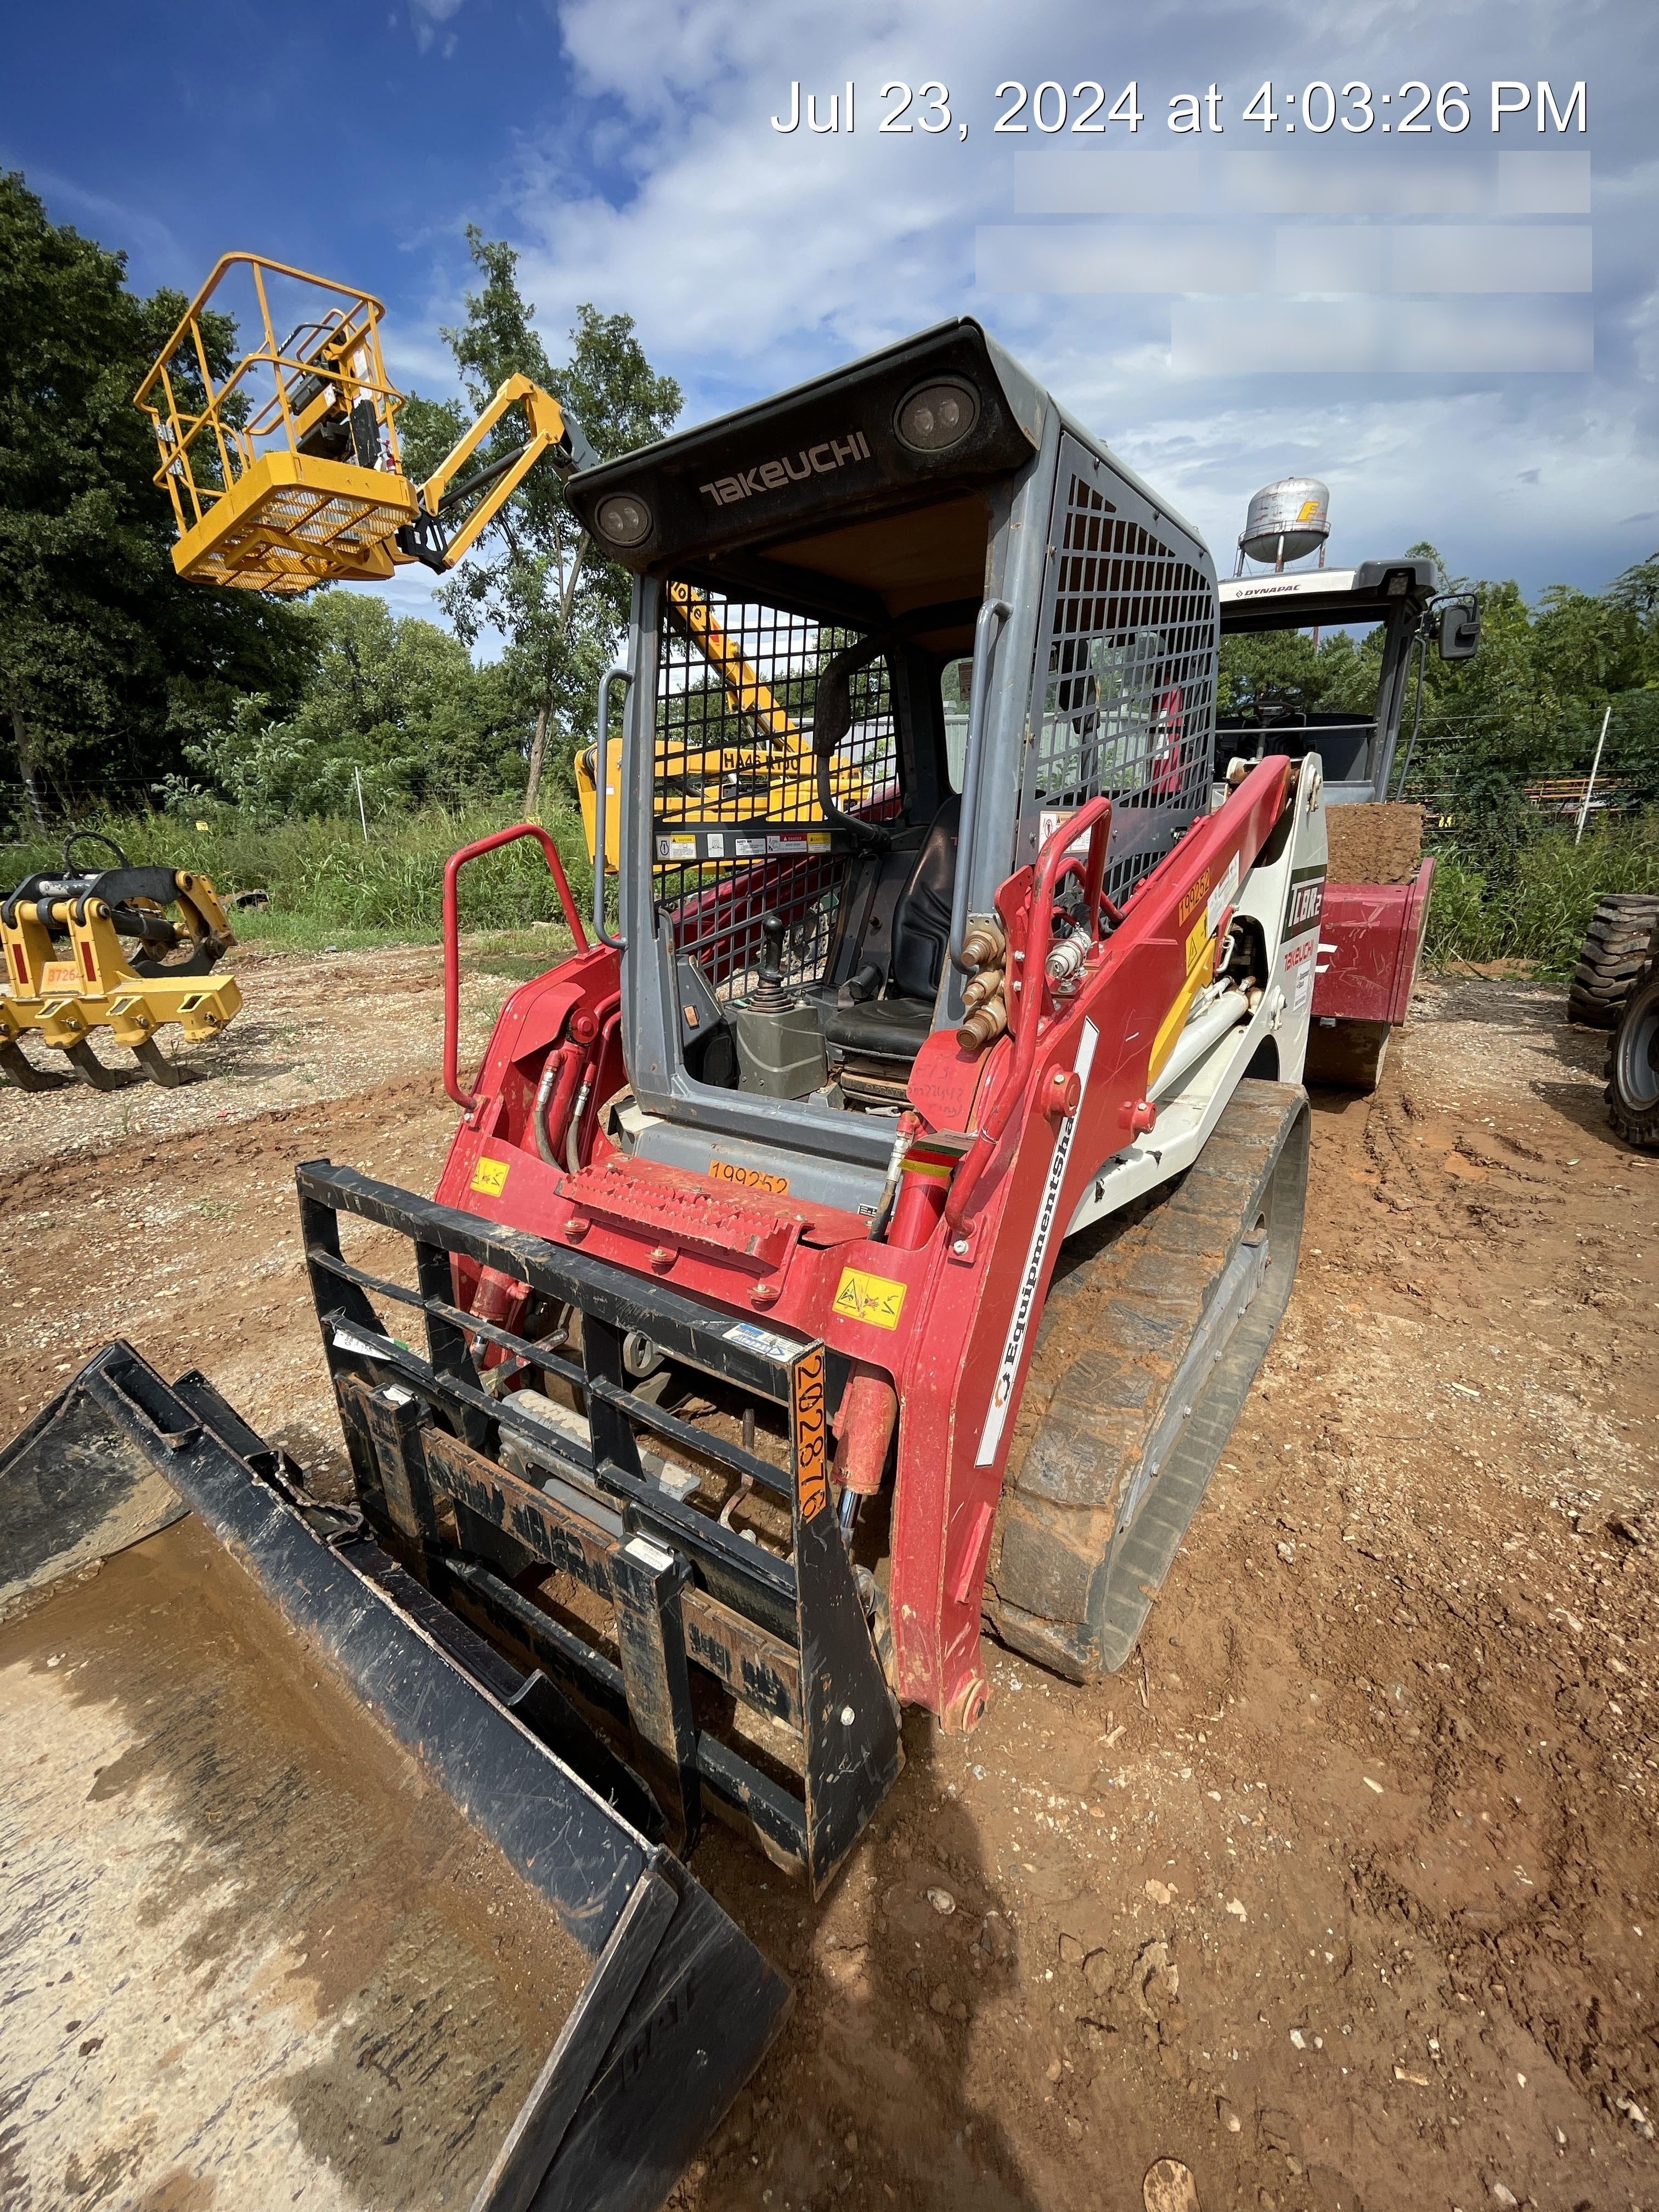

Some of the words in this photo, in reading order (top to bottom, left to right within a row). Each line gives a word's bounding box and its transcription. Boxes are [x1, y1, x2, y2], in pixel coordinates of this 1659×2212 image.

[699, 431, 871, 506] TAKEUCHI
[1244, 584, 1301, 596] DYNAPAC
[1180, 870, 1210, 922] 199252
[712, 1162, 788, 1194] 199252
[1004, 1115, 1075, 1366] EquipmentSha
